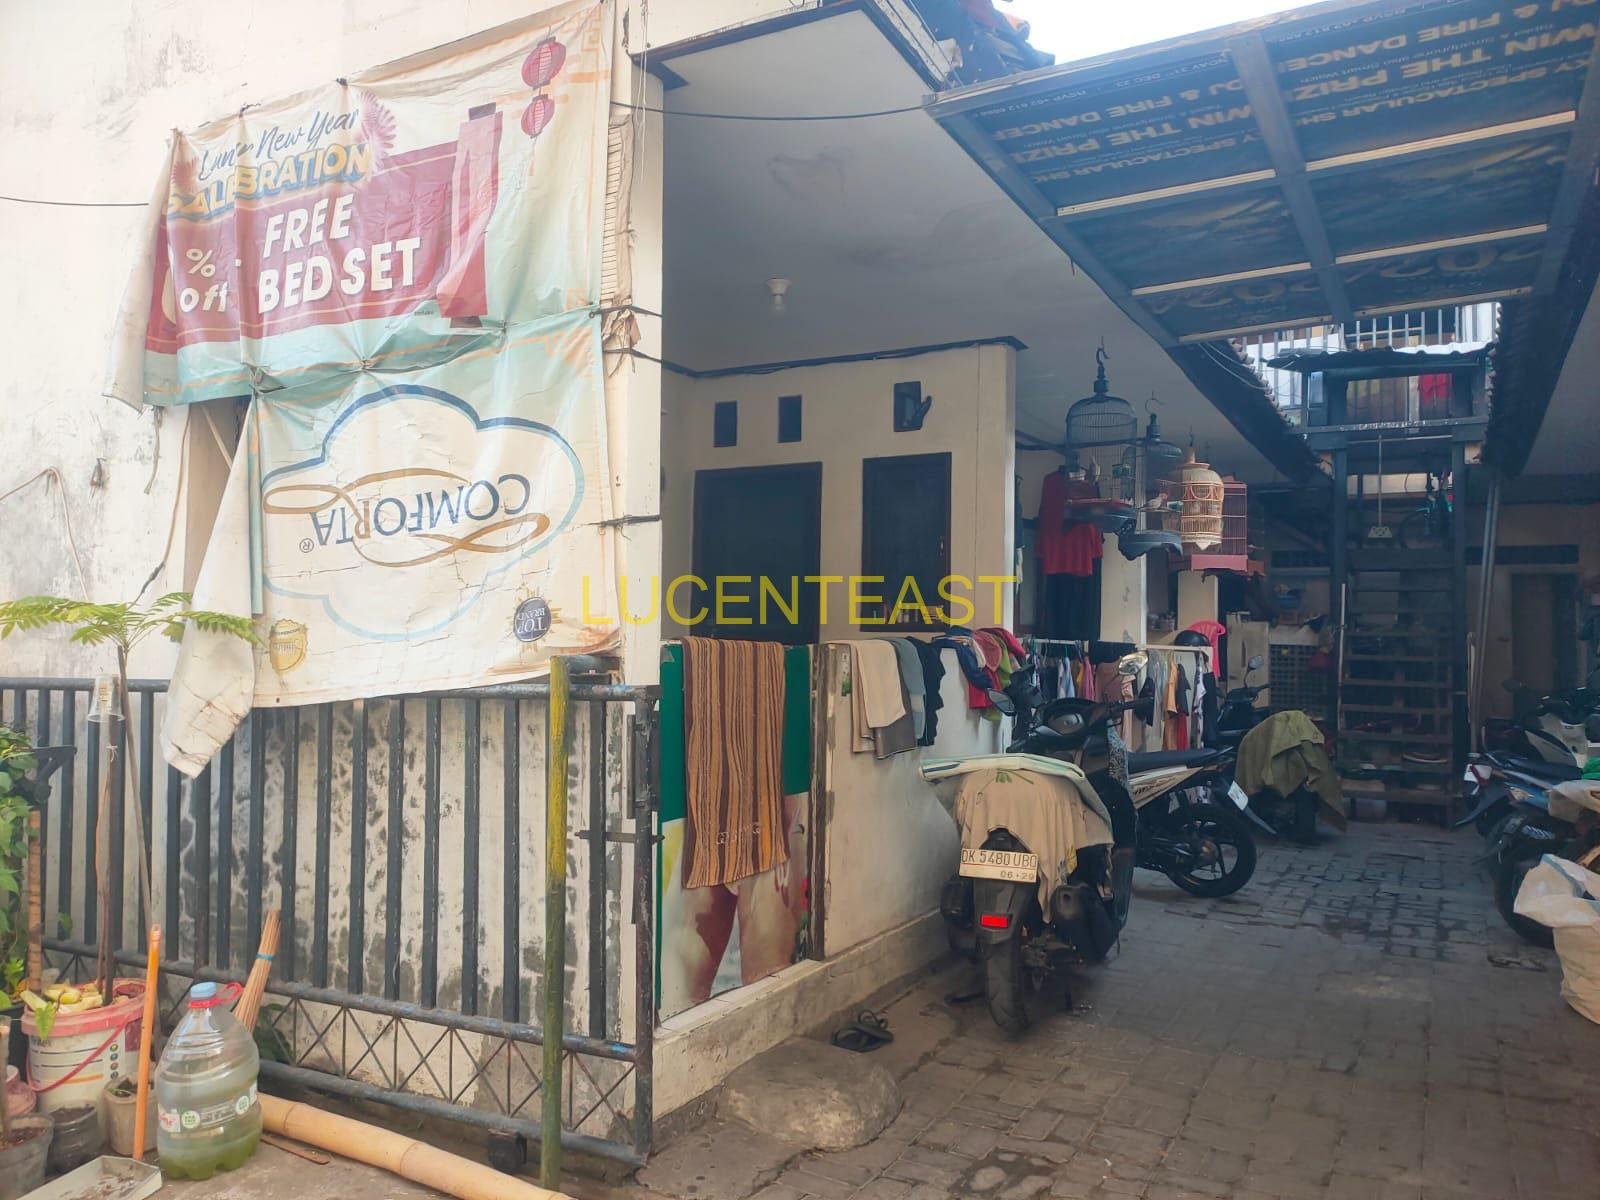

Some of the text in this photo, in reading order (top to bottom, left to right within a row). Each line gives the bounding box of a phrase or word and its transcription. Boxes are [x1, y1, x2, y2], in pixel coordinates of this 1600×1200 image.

[1417, 12, 1501, 43] FIRE
[1504, 23, 1596, 56] WIN
[1400, 48, 1492, 79] THE
[1105, 95, 1174, 119] FIRE
[1342, 66, 1548, 117] SPECTACULAR
[1187, 104, 1252, 130] WIN
[256, 126, 305, 159] New
[307, 109, 359, 150] Year
[1104, 122, 1182, 146] THE
[1073, 138, 1238, 176] SPECTACULAR
[263, 194, 353, 258] FREE
[186, 248, 216, 277] %
[258, 237, 421, 314] BED SET
[309, 474, 531, 546] COMFORTA
[517, 616, 547, 634] TOP
[962, 849, 976, 863] DK
